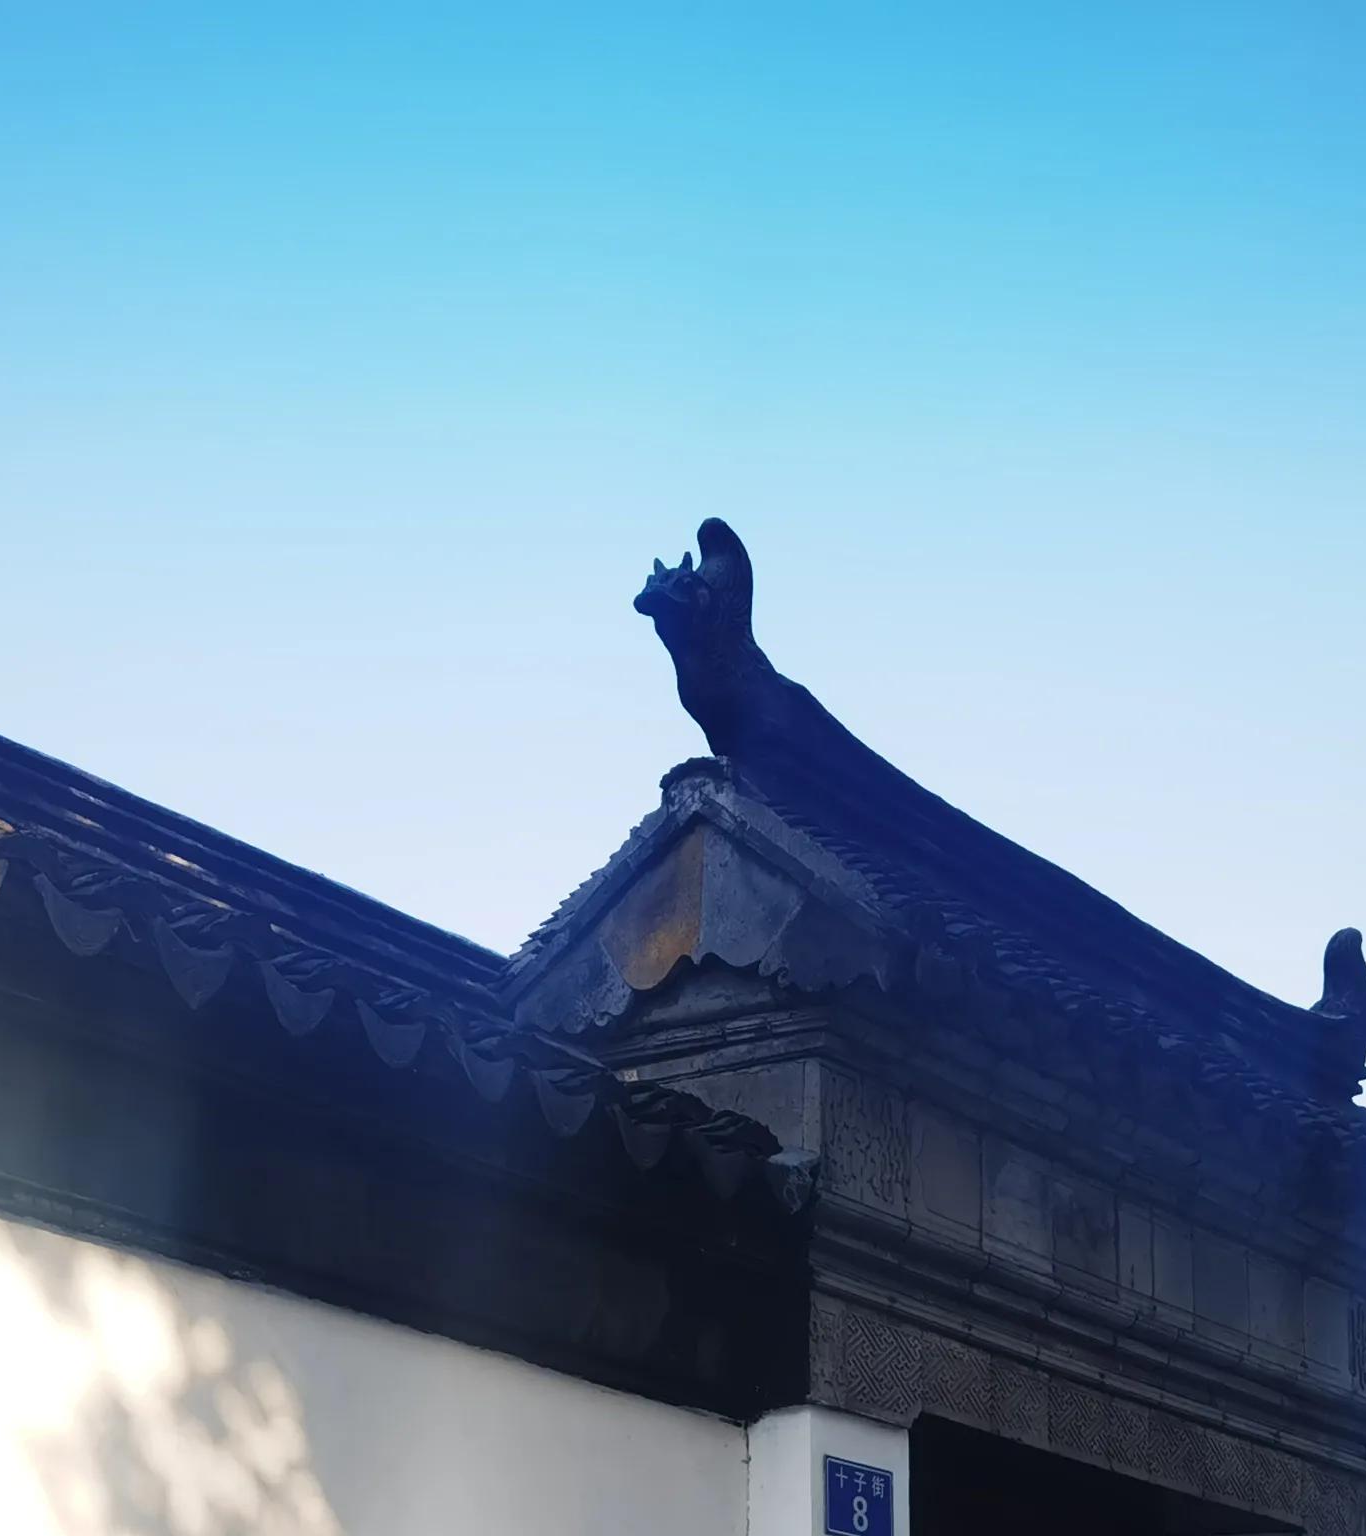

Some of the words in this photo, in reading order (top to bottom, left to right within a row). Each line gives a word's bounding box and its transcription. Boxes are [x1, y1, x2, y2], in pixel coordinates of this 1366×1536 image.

[835, 1466, 885, 1499] 十子街
[853, 1495, 869, 1532] 8
